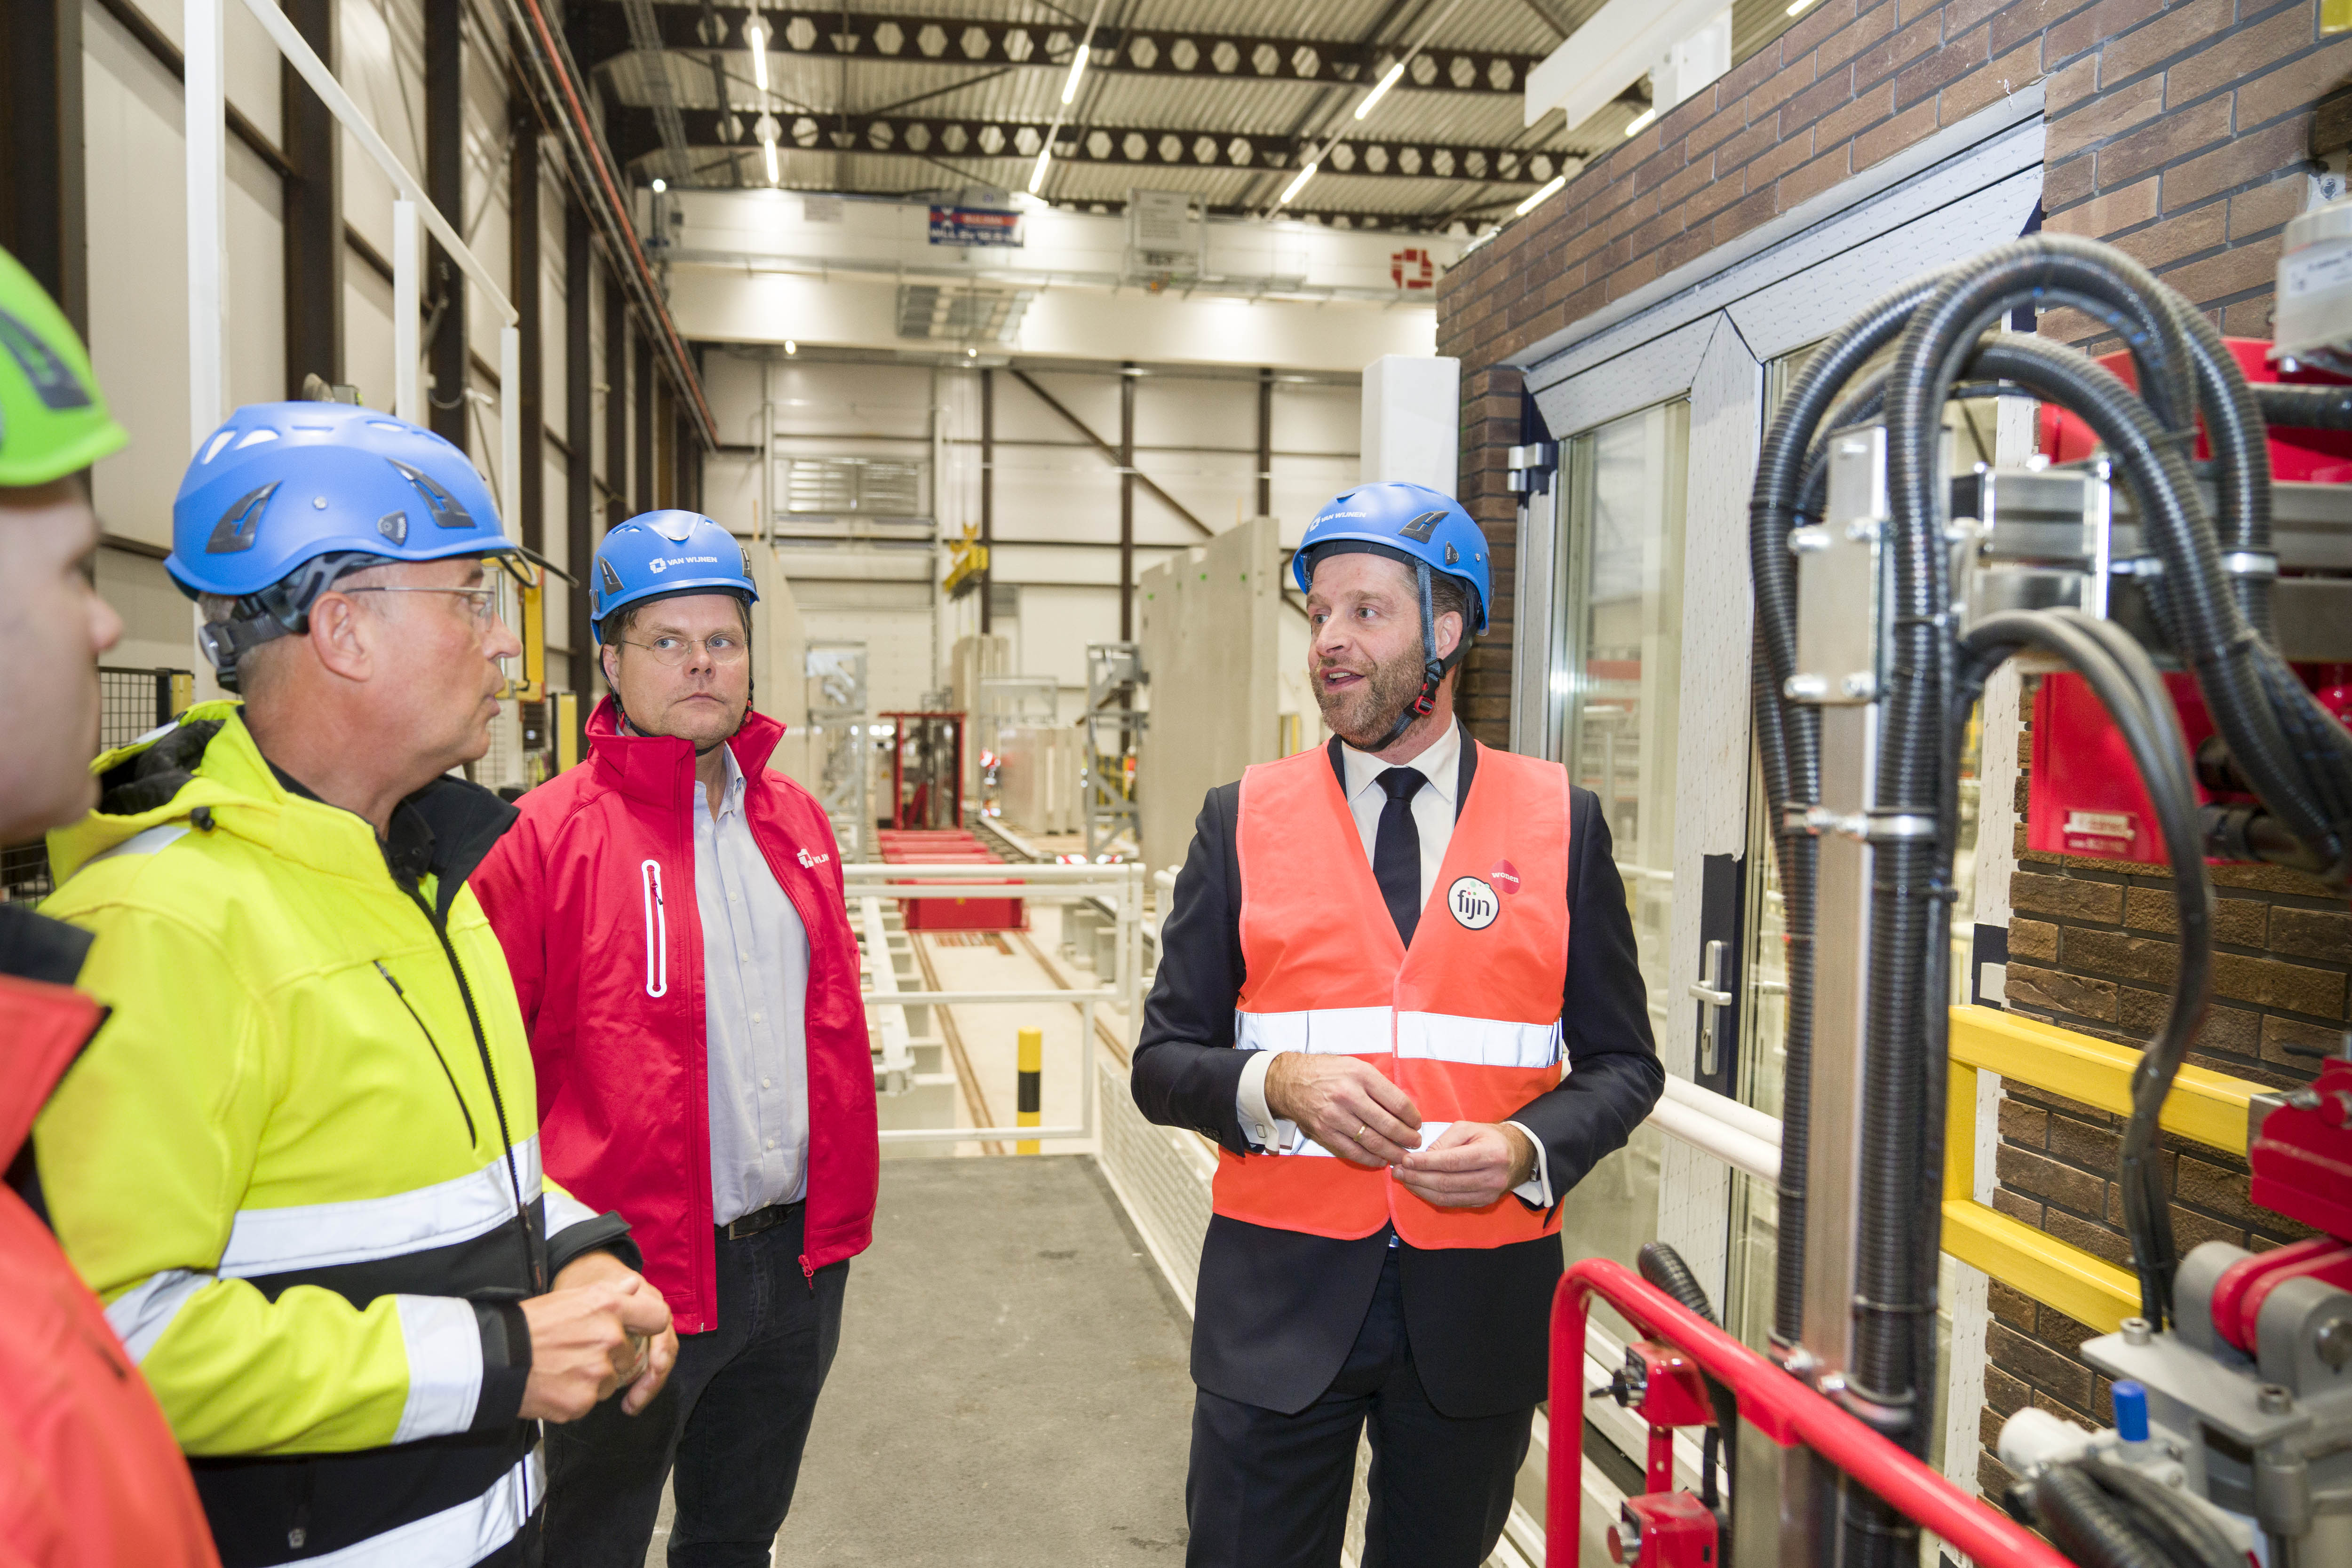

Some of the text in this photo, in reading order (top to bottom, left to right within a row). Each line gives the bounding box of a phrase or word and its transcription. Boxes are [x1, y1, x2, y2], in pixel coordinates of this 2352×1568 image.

[1321, 514, 1334, 523] VAN
[1491, 872, 1519, 883] wonen
[1457, 889, 1490, 920] fijn
